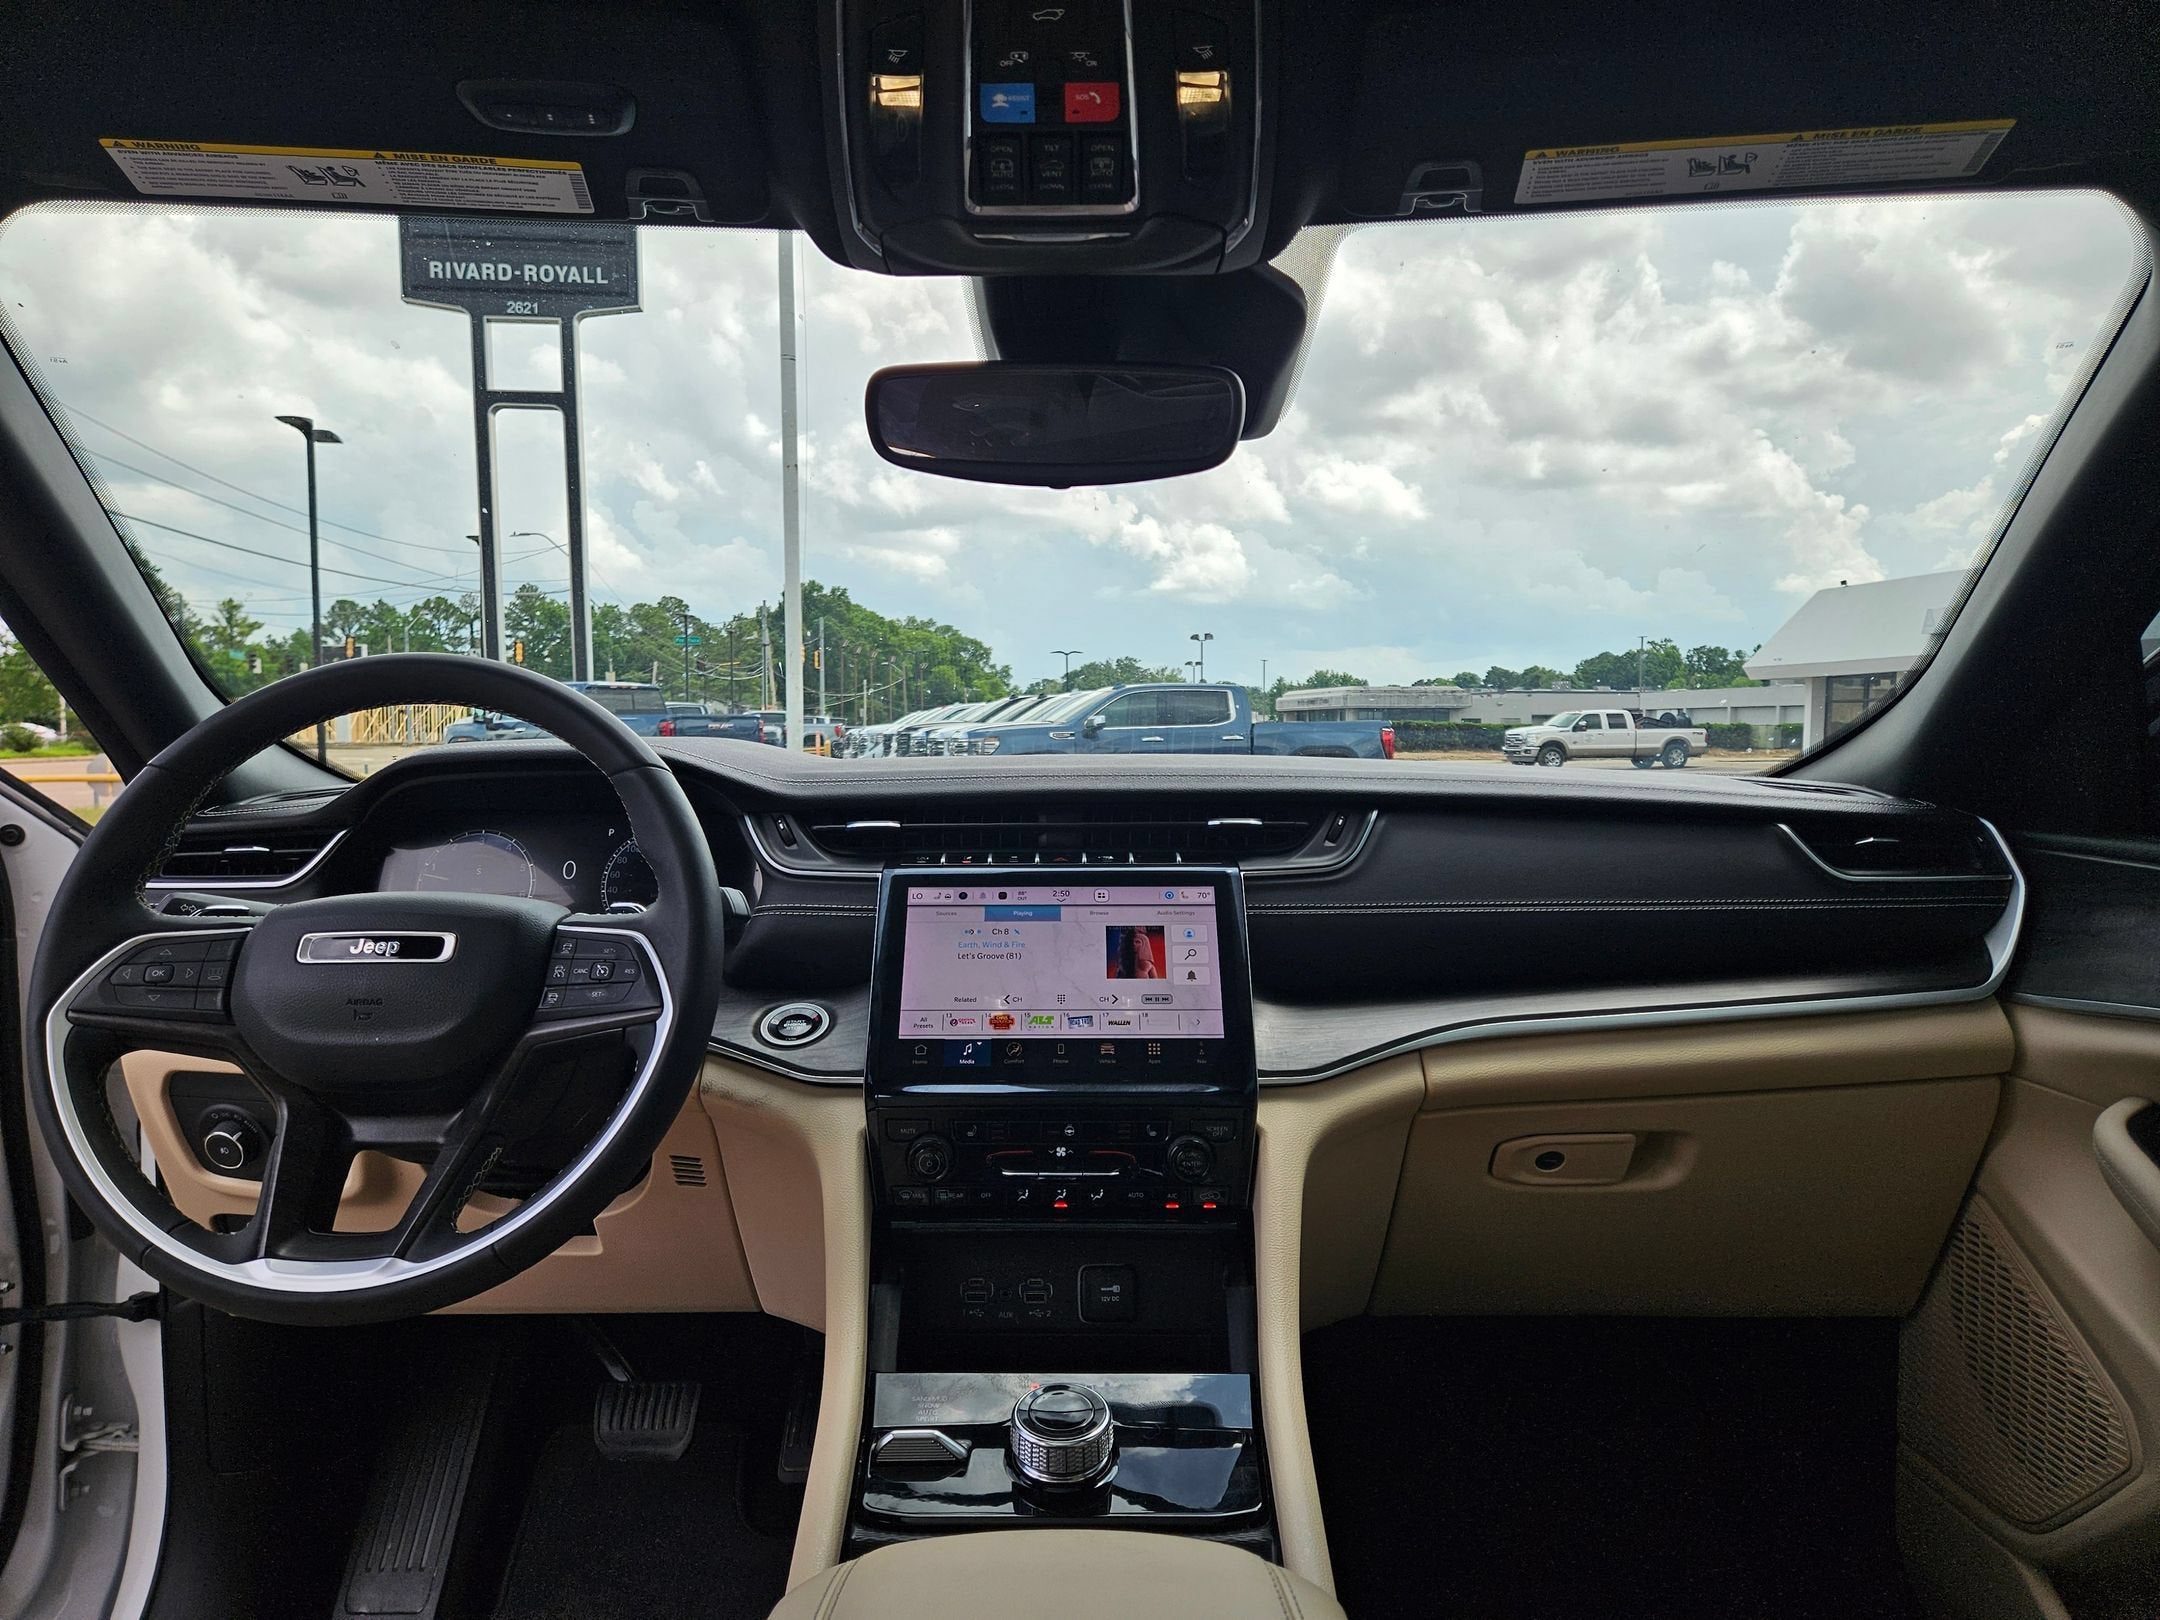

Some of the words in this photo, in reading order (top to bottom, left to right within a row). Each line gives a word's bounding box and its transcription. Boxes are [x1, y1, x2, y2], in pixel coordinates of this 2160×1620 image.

[1813, 131, 1846, 140] MISE
[1851, 129, 1872, 138] EN
[1874, 126, 1924, 137] GARDE
[131, 141, 201, 151] WARNING
[1555, 146, 1621, 158] WARNING
[392, 152, 428, 161] MISE
[430, 154, 449, 162] EN
[451, 156, 497, 165] GARDE
[428, 260, 609, 285] RIVARD-ROYALL
[506, 300, 539, 315] 2621
[608, 828, 616, 837] P
[505, 843, 512, 852] 4
[616, 856, 628, 865] 80
[519, 864, 526, 873] 5
[562, 860, 577, 880] 0
[609, 870, 621, 879] 60
[606, 885, 618, 894] 40
[1052, 889, 1071, 898] 2:50
[912, 892, 923, 900] LO
[1197, 891, 1211, 899] 70°
[1174, 909, 1196, 917] Settings
[991, 928, 1003, 936] Ch
[1003, 928, 1010, 936] 8
[349, 937, 401, 957] Jeep
[958, 941, 981, 949] Earth,
[982, 941, 1003, 949] Wind
[1003, 941, 1010, 949] &
[1011, 941, 1026, 949] Fire
[957, 952, 976, 960] Let's
[976, 952, 1005, 960] Groove
[1006, 952, 1023, 961] (81)
[151, 969, 166, 977] OK
[345, 998, 384, 1006] AIRBAG
[1028, 1015, 1055, 1025] ALT
[913, 1022, 934, 1030] Presets
[1128, 1191, 1145, 1199] AUTO
